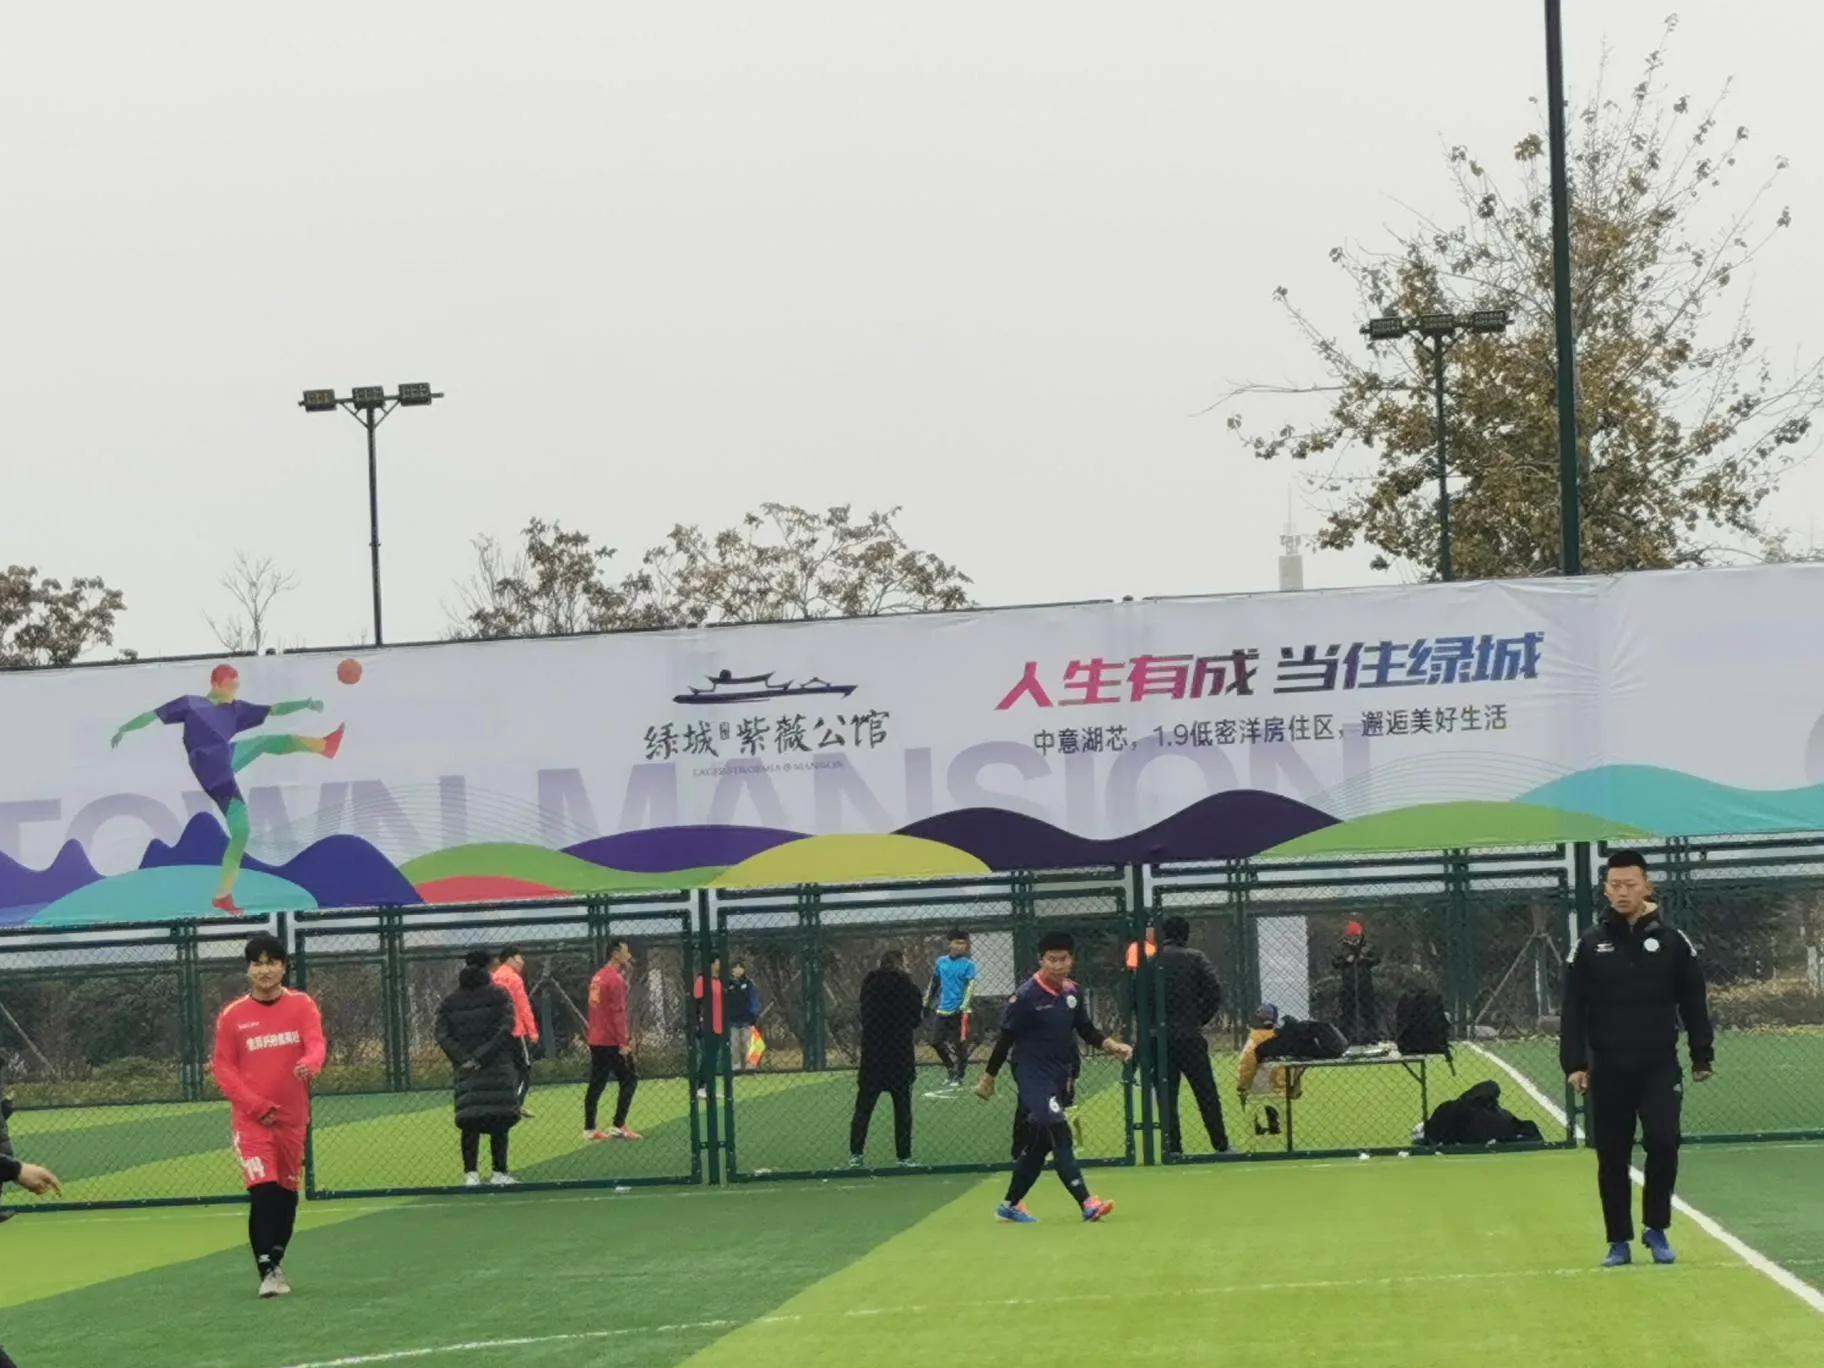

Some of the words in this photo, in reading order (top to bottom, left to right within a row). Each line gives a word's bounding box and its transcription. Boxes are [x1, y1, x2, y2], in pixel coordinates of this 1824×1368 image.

[994, 648, 1259, 711] 人生有成
[1273, 631, 1546, 694] 当住绿城
